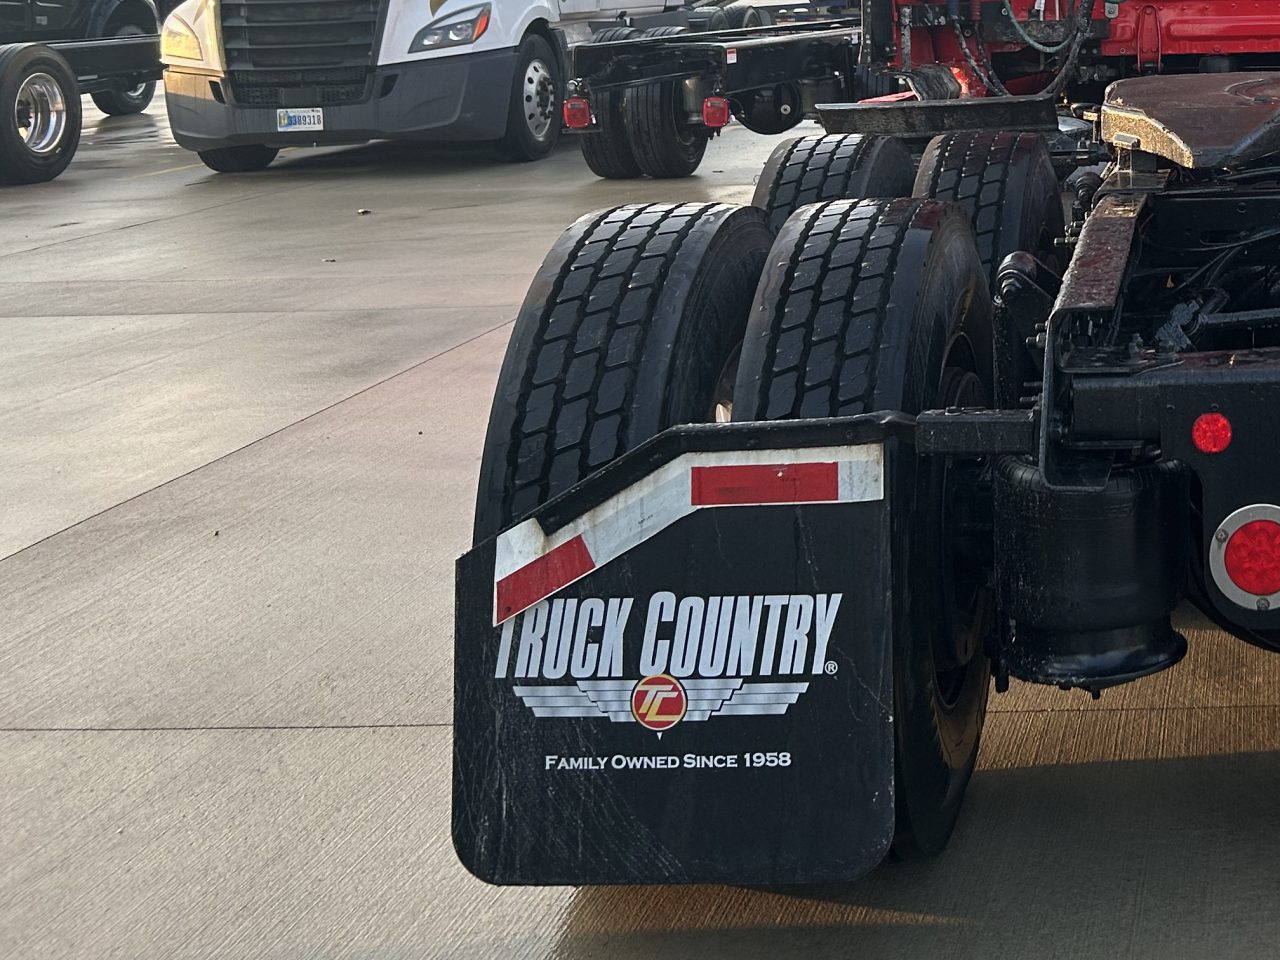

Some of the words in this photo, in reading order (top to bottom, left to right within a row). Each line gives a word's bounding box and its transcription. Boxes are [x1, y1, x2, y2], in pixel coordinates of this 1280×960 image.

[545, 754, 608, 770] FAMILY
[611, 754, 679, 770] OWNED
[683, 753, 738, 769] SINCE
[743, 752, 792, 767] 1958
